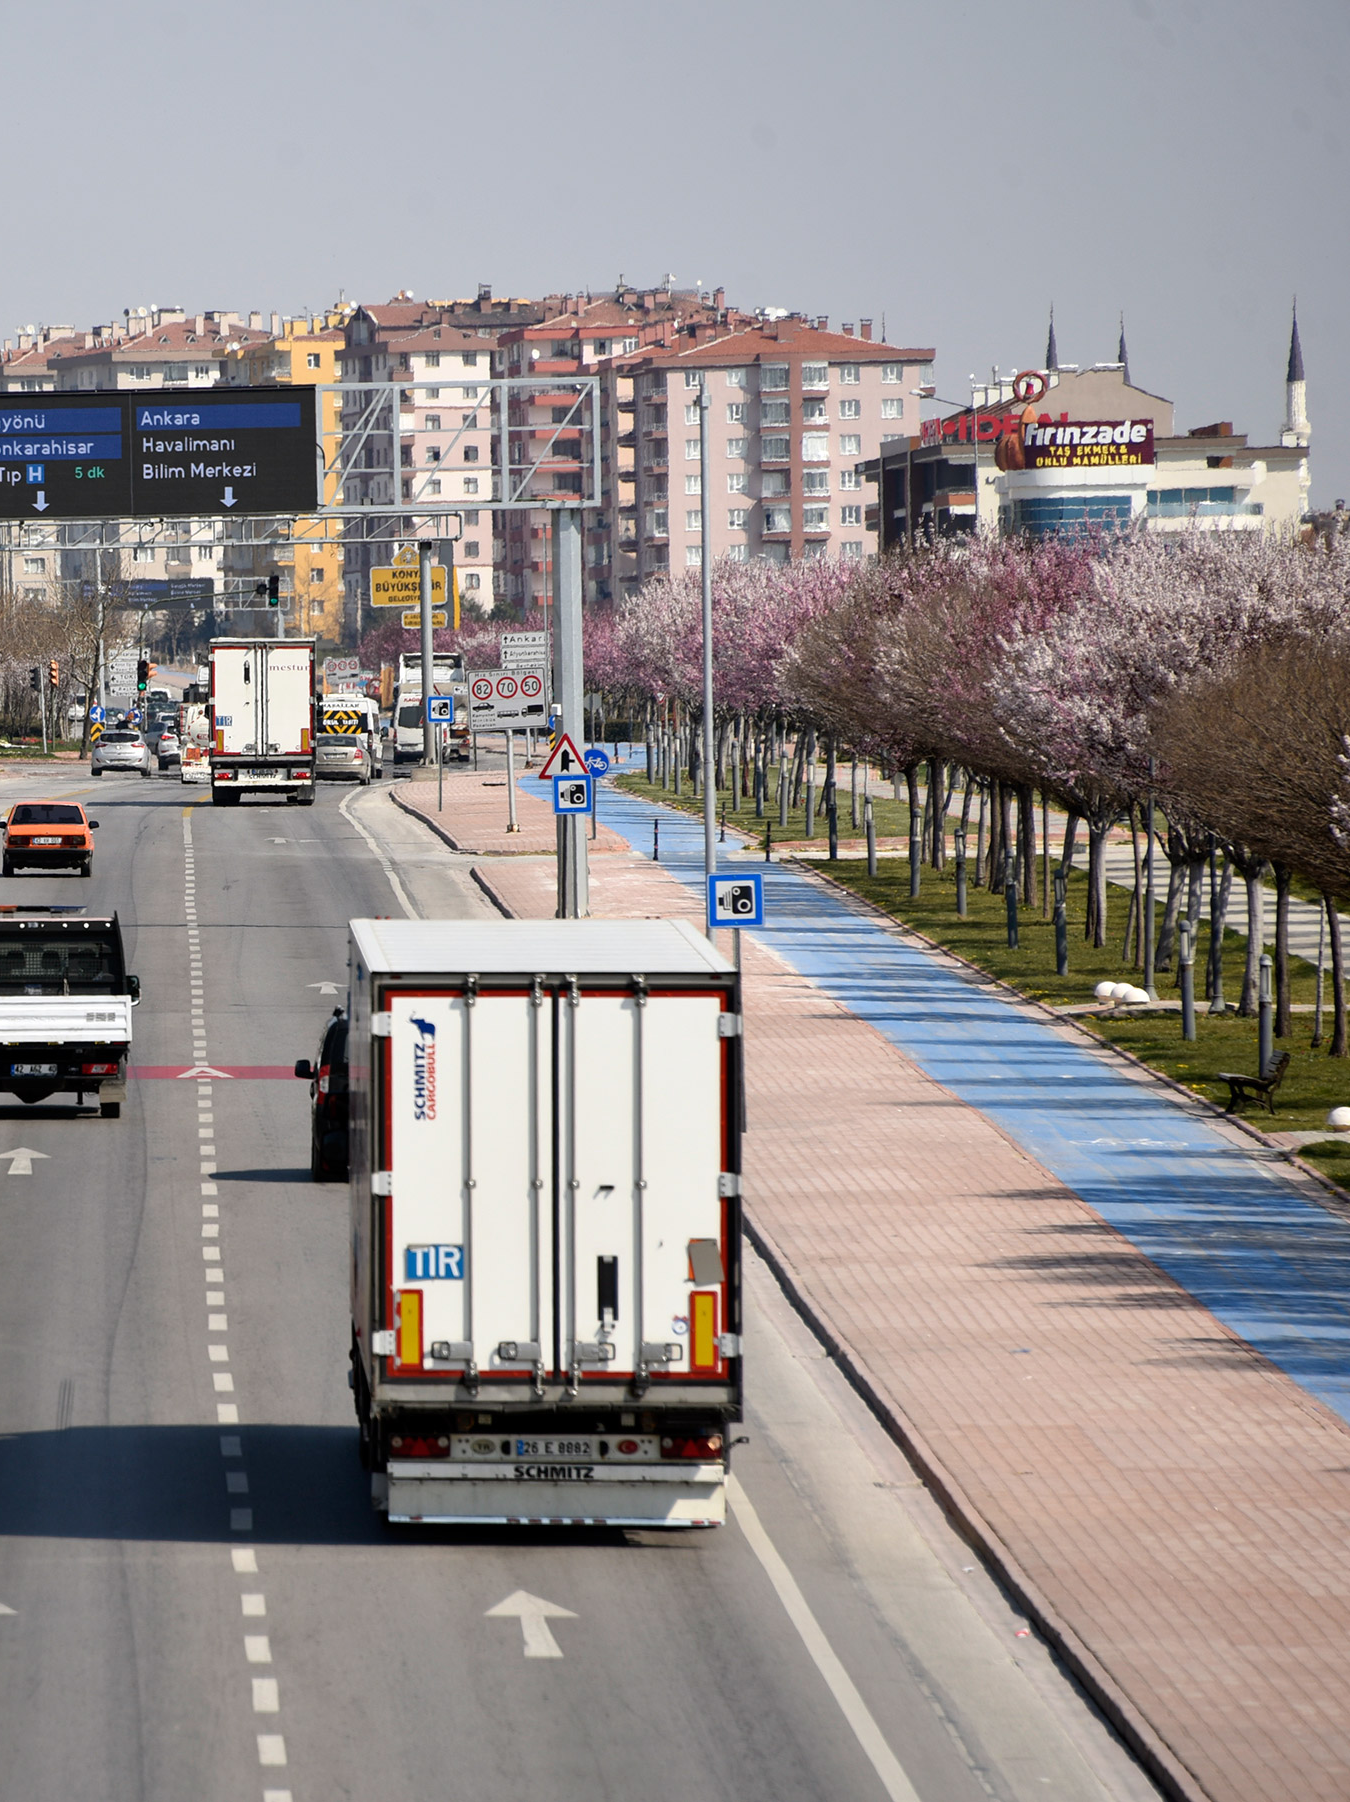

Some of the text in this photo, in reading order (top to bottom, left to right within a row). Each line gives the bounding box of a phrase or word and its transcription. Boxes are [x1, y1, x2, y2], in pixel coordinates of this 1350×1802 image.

[141, 410, 200, 426] Ankara
[142, 436, 235, 453] Havalimanı
[1049, 446, 1071, 457] TAŞ
[1076, 445, 1117, 456] EKMEK
[74, 466, 84, 479] 5
[87, 466, 106, 479] dk
[142, 462, 257, 480] Bilim Merkezi
[392, 570, 421, 579] KONY
[476, 684, 490, 695] 82
[500, 682, 514, 694] 70
[524, 680, 539, 692] 50
[216, 715, 233, 727] TIR
[414, 1043, 427, 1121] SCHMITZ
[426, 1043, 437, 1121] CARGOBULL
[409, 1245, 461, 1278] TIR
[524, 1441, 539, 1454] 26
[544, 1441, 553, 1454] E
[513, 1464, 595, 1480] SCHMITZ
